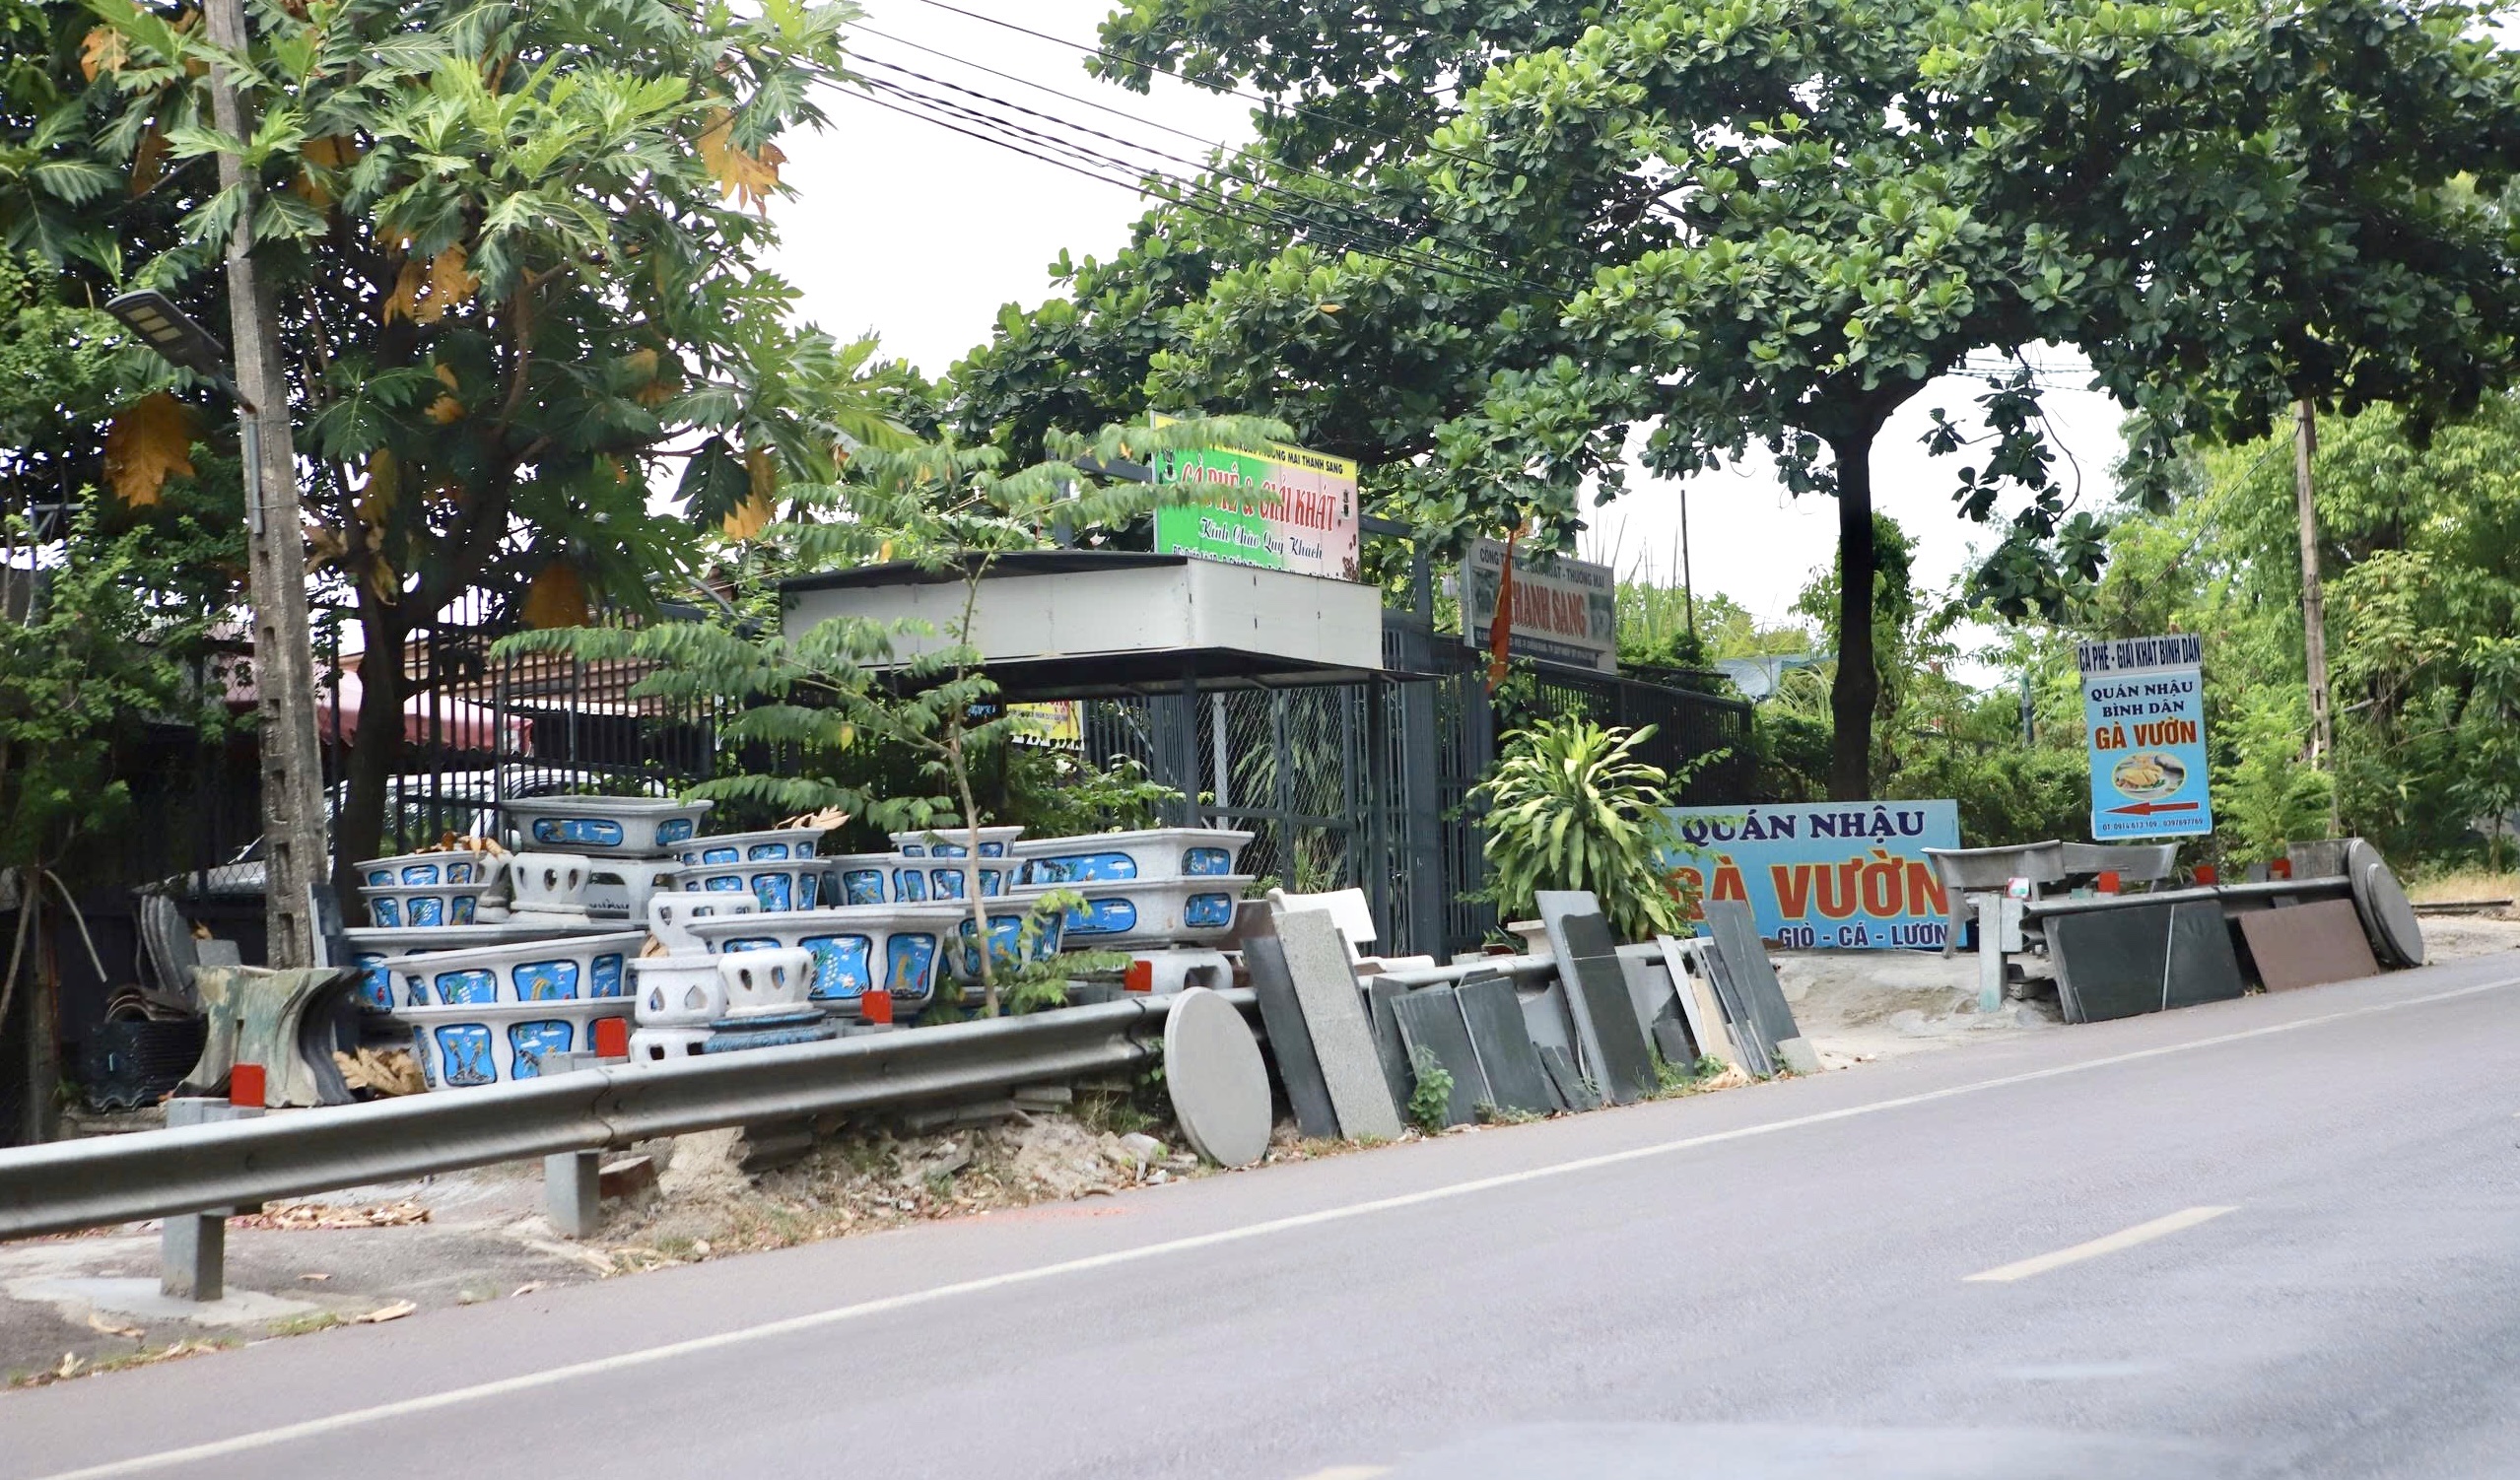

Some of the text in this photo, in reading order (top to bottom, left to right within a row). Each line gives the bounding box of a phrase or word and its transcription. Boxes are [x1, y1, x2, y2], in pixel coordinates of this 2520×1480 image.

[1302, 455, 1325, 470] THANH
[1327, 460, 1343, 474] SANG
[1294, 483, 1336, 532] KHÁT
[1289, 536, 1323, 560] Khách
[1479, 545, 1499, 566] CÔNG
[1552, 589, 1587, 639] SANG
[2136, 636, 2157, 667] KHÁT
[2159, 637, 2181, 665] BÌNH
[2091, 680, 2193, 702] QUÁN NHẬU
[2102, 698, 2184, 718] BÌNH DÂN
[2094, 716, 2198, 751] GÀ VƯỜN
[1682, 804, 1925, 846] QUÁN NHẬU
[1665, 849, 1948, 921] GÀ VƯỜN
[1778, 922, 1814, 947] GIÒ
[1839, 922, 1869, 946] CÁ
[1892, 923, 1947, 946] LƯƠN
